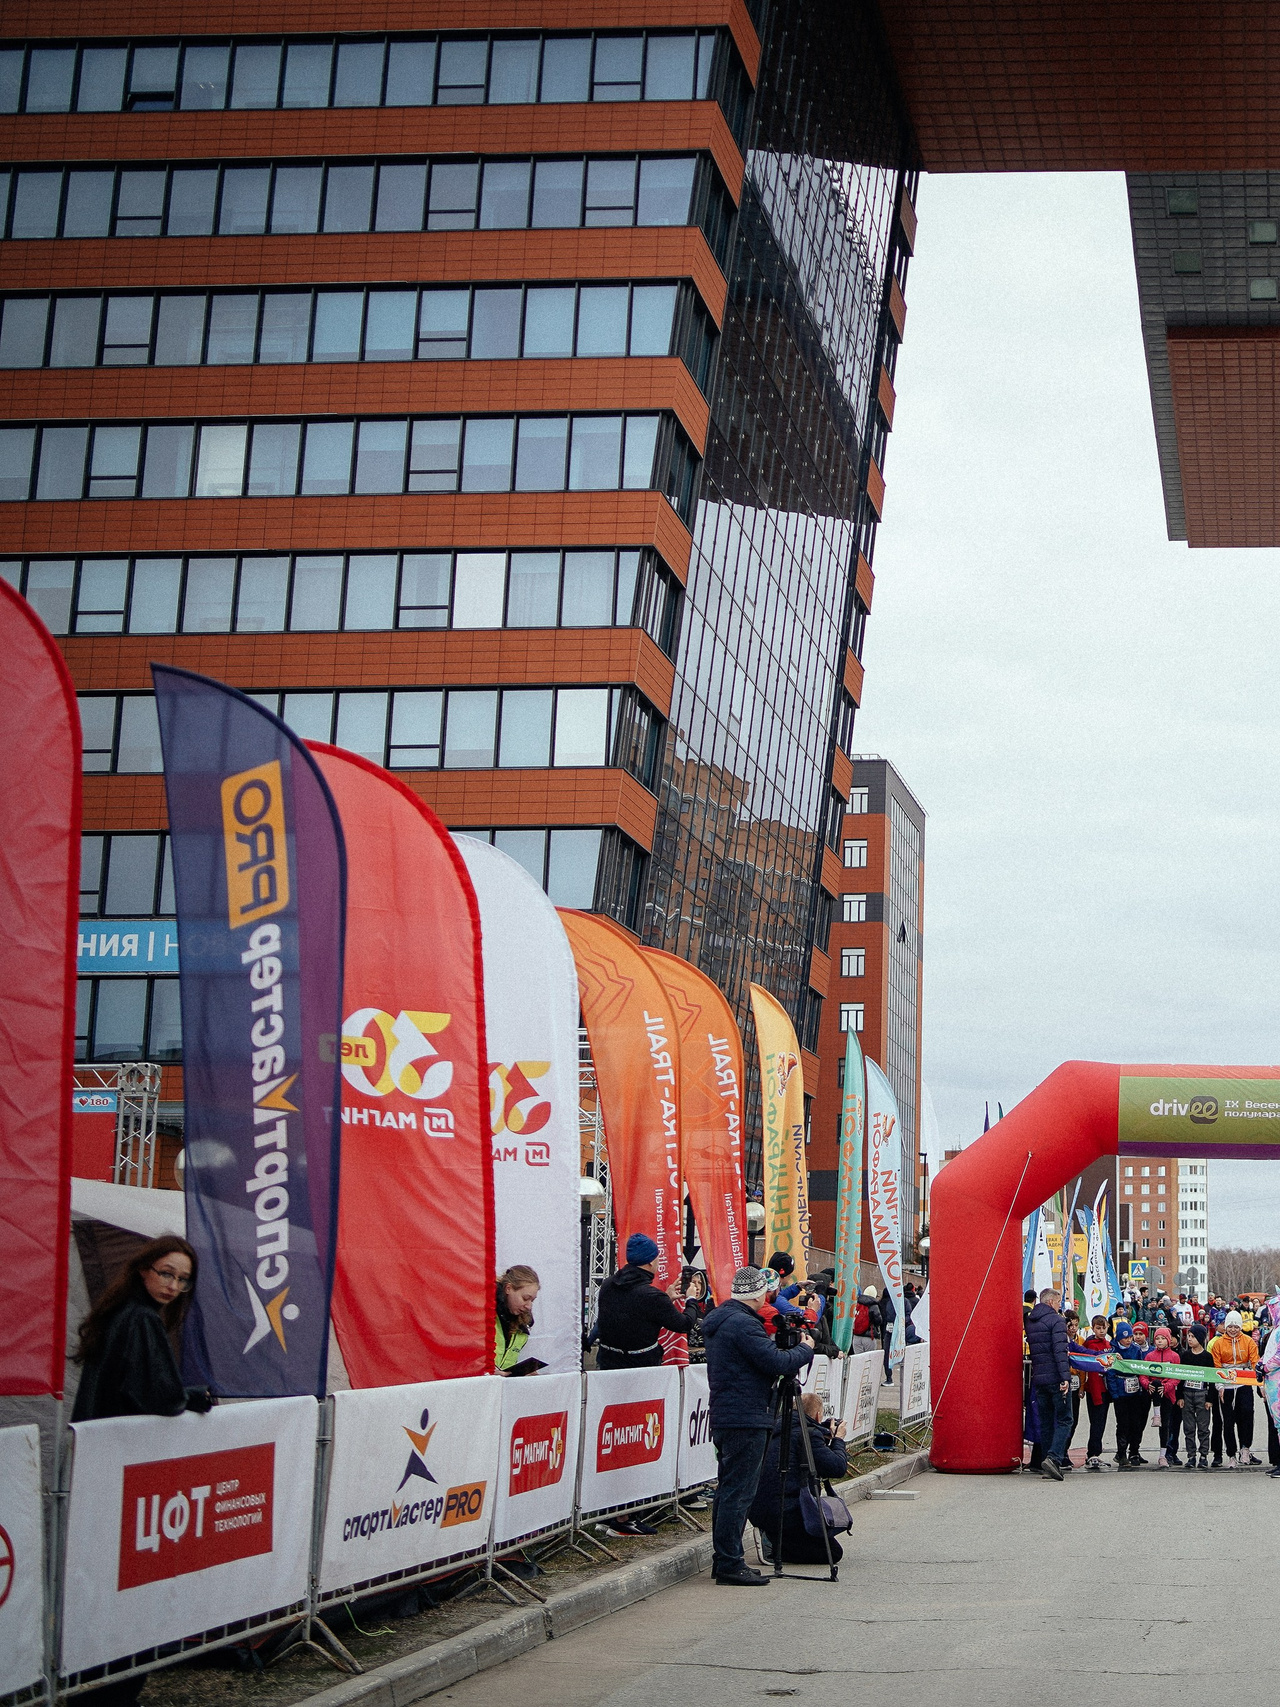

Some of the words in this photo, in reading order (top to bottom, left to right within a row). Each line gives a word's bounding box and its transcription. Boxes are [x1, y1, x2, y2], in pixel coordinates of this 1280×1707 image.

[90, 1097, 109, 1106] 180
[1149, 1098, 1219, 1119] drivee
[614, 1424, 644, 1446] МАГНИТ
[523, 1440, 550, 1466] МАГНИТ
[216, 1479, 240, 1496] ЦЕНТР
[214, 1492, 266, 1514] ФИНАНСОВЫХ
[443, 1488, 483, 1522] PRO
[135, 1484, 212, 1553] ЦФТ
[214, 1508, 263, 1533] ТЕХНОЛОГИЙ
